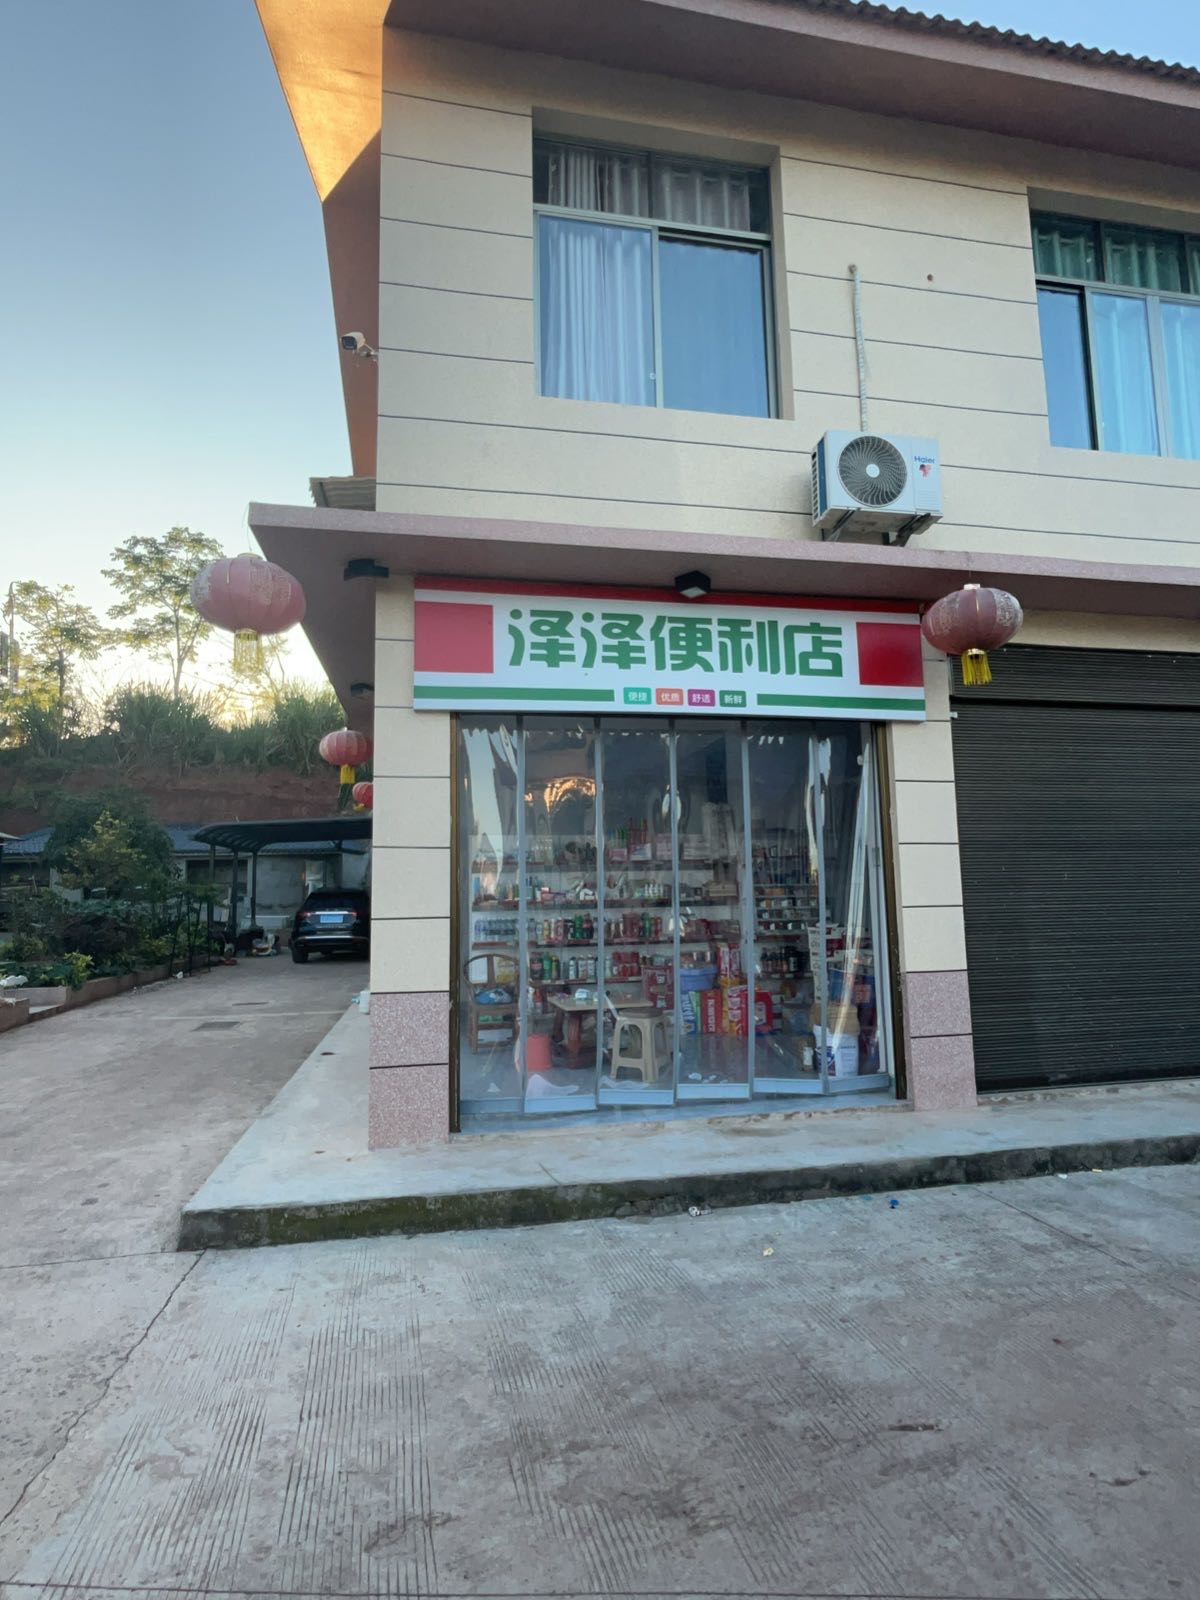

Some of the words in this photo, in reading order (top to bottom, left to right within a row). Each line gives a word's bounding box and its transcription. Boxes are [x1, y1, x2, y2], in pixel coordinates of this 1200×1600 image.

[914, 455, 935, 464] Haier
[508, 608, 843, 677] 泽泽便利店
[661, 692, 680, 703] 优质
[692, 693, 711, 704] 舒适
[724, 694, 743, 705] 新鲜
